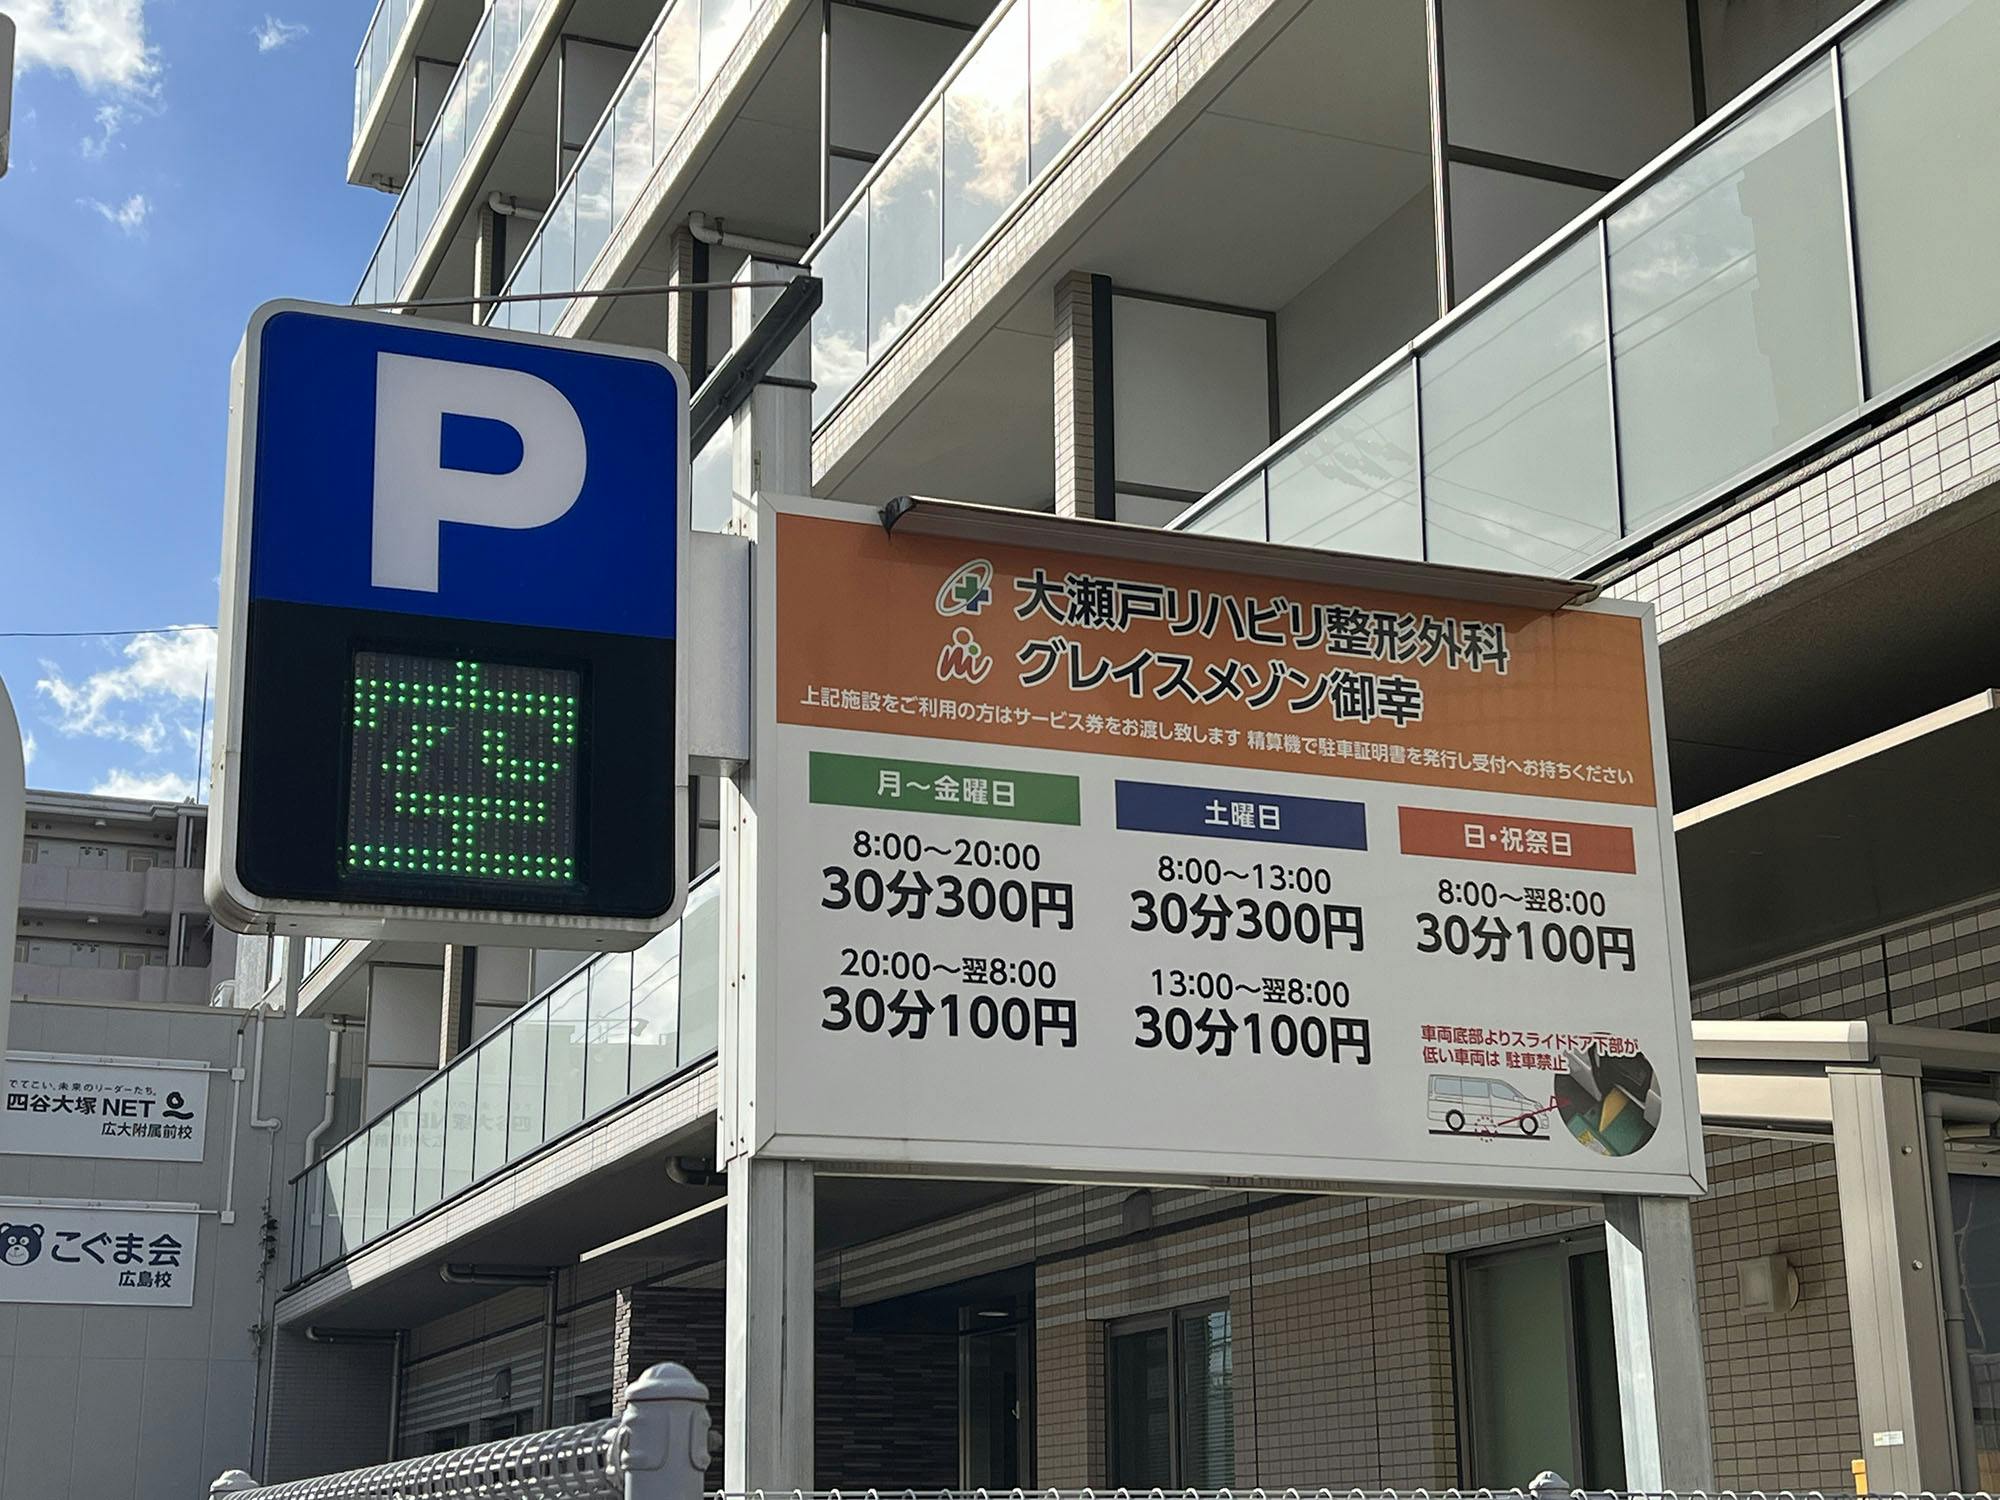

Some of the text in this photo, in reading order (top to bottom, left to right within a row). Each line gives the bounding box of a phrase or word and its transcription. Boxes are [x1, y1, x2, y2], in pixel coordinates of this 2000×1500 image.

[371, 351, 587, 593] P
[1015, 568, 1509, 675] 大瀬戸リハビリ整形外科
[1017, 637, 1423, 726] グレイスメゾン御幸
[800, 684, 1634, 785] 上記施設をご利用の方はサービス券をお渡し致します 精算機で駐車証明書を発行し受付へお持ちください
[350, 660, 576, 879] 空
[877, 769, 1015, 807] 月～金曜日
[1204, 799, 1280, 830] 土曜日
[1464, 823, 1572, 857] 日・祝祭日
[821, 866, 1074, 930] 30分300円
[1130, 889, 1364, 951] 30分300円
[1416, 912, 1636, 972] 30分100円
[821, 986, 1077, 1048] 30分100円
[1134, 1005, 1371, 1065] 30分100円
[1421, 1025, 1639, 1055] 車両底部よりスライドドア下部が
[1423, 1046, 1568, 1072] 低い車両は 駐車禁止
[7, 1093, 156, 1118] 四谷大塚 NET
[101, 1121, 193, 1140] 広大附属前校
[52, 1231, 182, 1267] こぐま会
[118, 1271, 172, 1289] 広島校
